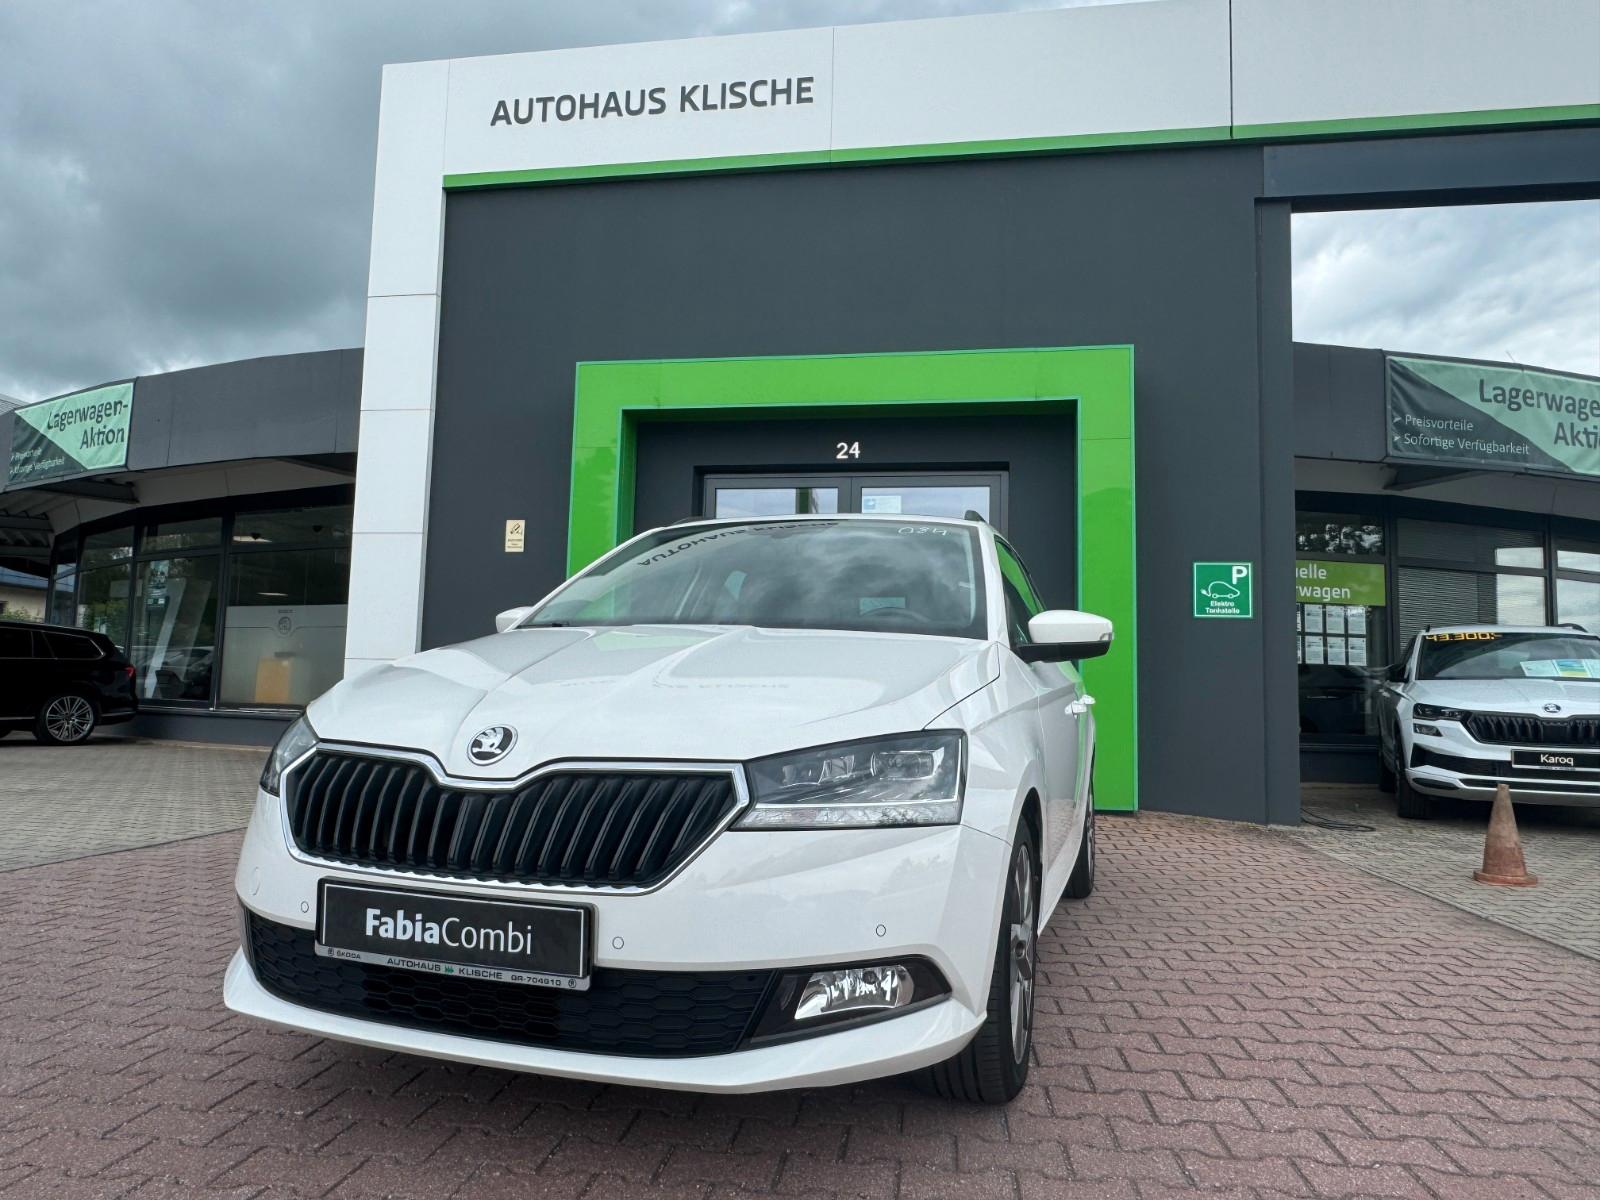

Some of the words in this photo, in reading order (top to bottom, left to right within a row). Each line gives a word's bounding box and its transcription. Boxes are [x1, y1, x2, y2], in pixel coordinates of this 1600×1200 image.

[490, 87, 667, 127] AUTOHAUS
[680, 76, 815, 113] KLISCHE
[47, 399, 129, 432] Lagerwagen-
[1405, 414, 1474, 432] Preisvorteile
[80, 424, 125, 450] Aktion
[1404, 433, 1455, 450] Sofortige
[1457, 437, 1530, 455] Verfügbarkeit
[1553, 421, 1600, 450] Akti
[836, 441, 861, 459] 24
[1232, 566, 1247, 585] P
[1540, 754, 1574, 766] Karoq
[387, 957, 441, 972] AUTOHAUS
[458, 967, 503, 979] KLISCHE
